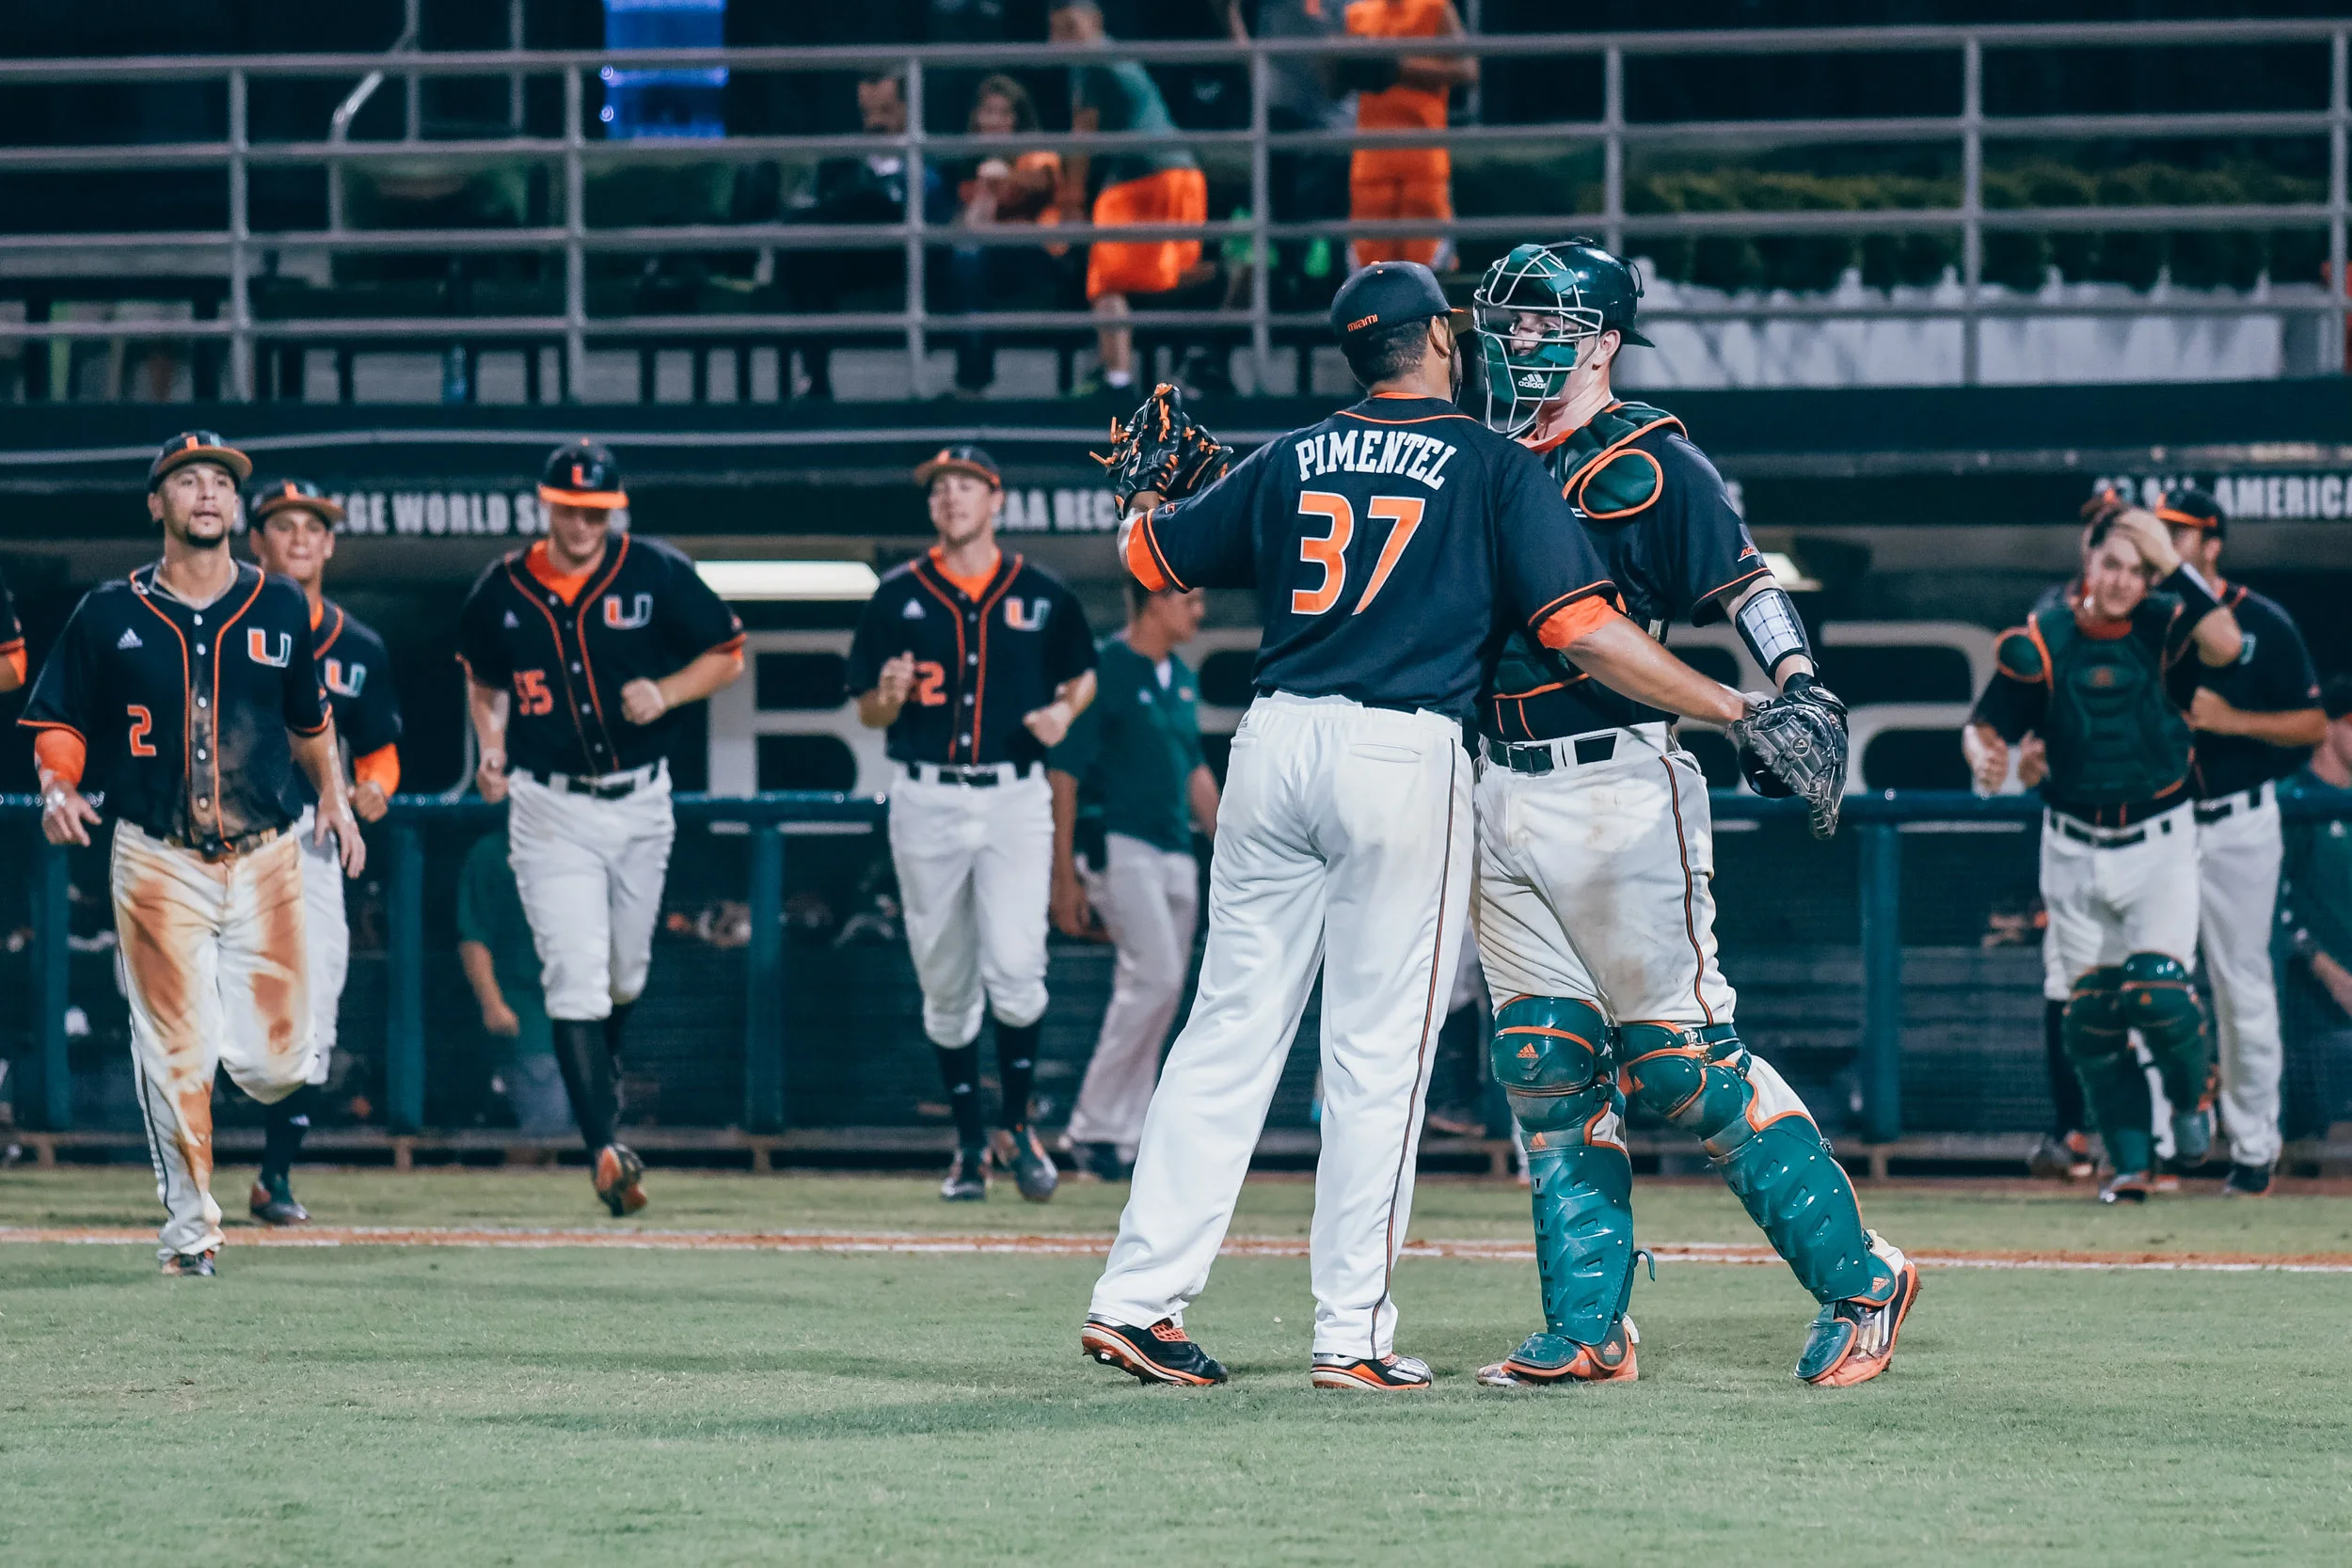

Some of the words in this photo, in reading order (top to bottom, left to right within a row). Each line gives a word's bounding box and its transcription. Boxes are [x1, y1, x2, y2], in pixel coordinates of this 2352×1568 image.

[1347, 313, 1378, 332] miami
[1518, 380, 1548, 389] adidas
[1295, 430, 1457, 490] PIMENTEL
[392, 492, 510, 535] WORLD
[1291, 491, 1426, 616] 37
[603, 593, 654, 629] U
[1004, 596, 1052, 632] U
[247, 627, 292, 668] U
[325, 658, 367, 698] U
[911, 661, 947, 705] 2
[126, 704, 156, 756] 2
